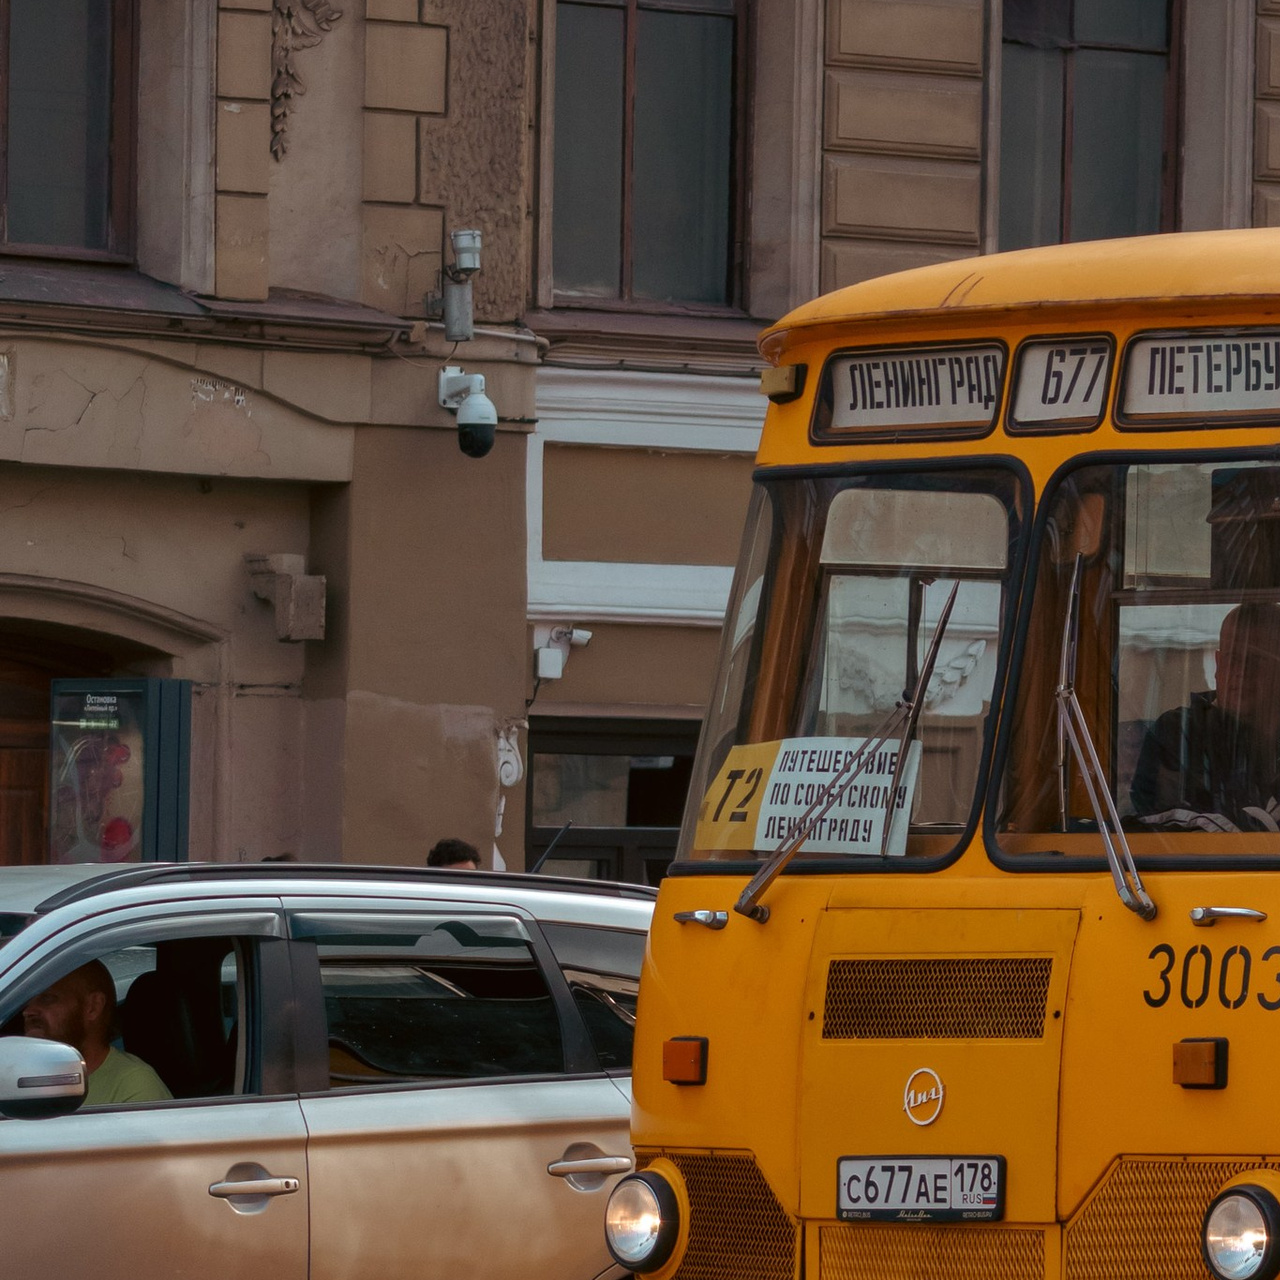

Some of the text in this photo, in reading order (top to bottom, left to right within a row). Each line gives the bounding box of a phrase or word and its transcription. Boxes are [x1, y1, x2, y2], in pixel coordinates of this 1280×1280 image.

[849, 354, 1000, 410] ЛЕНИНГРАД
[1041, 347, 1108, 405] 677
[86, 693, 117, 704] Остановка
[769, 782, 789, 806] ПО
[954, 1162, 993, 1193] 178
[962, 1194, 982, 1204] RUS
